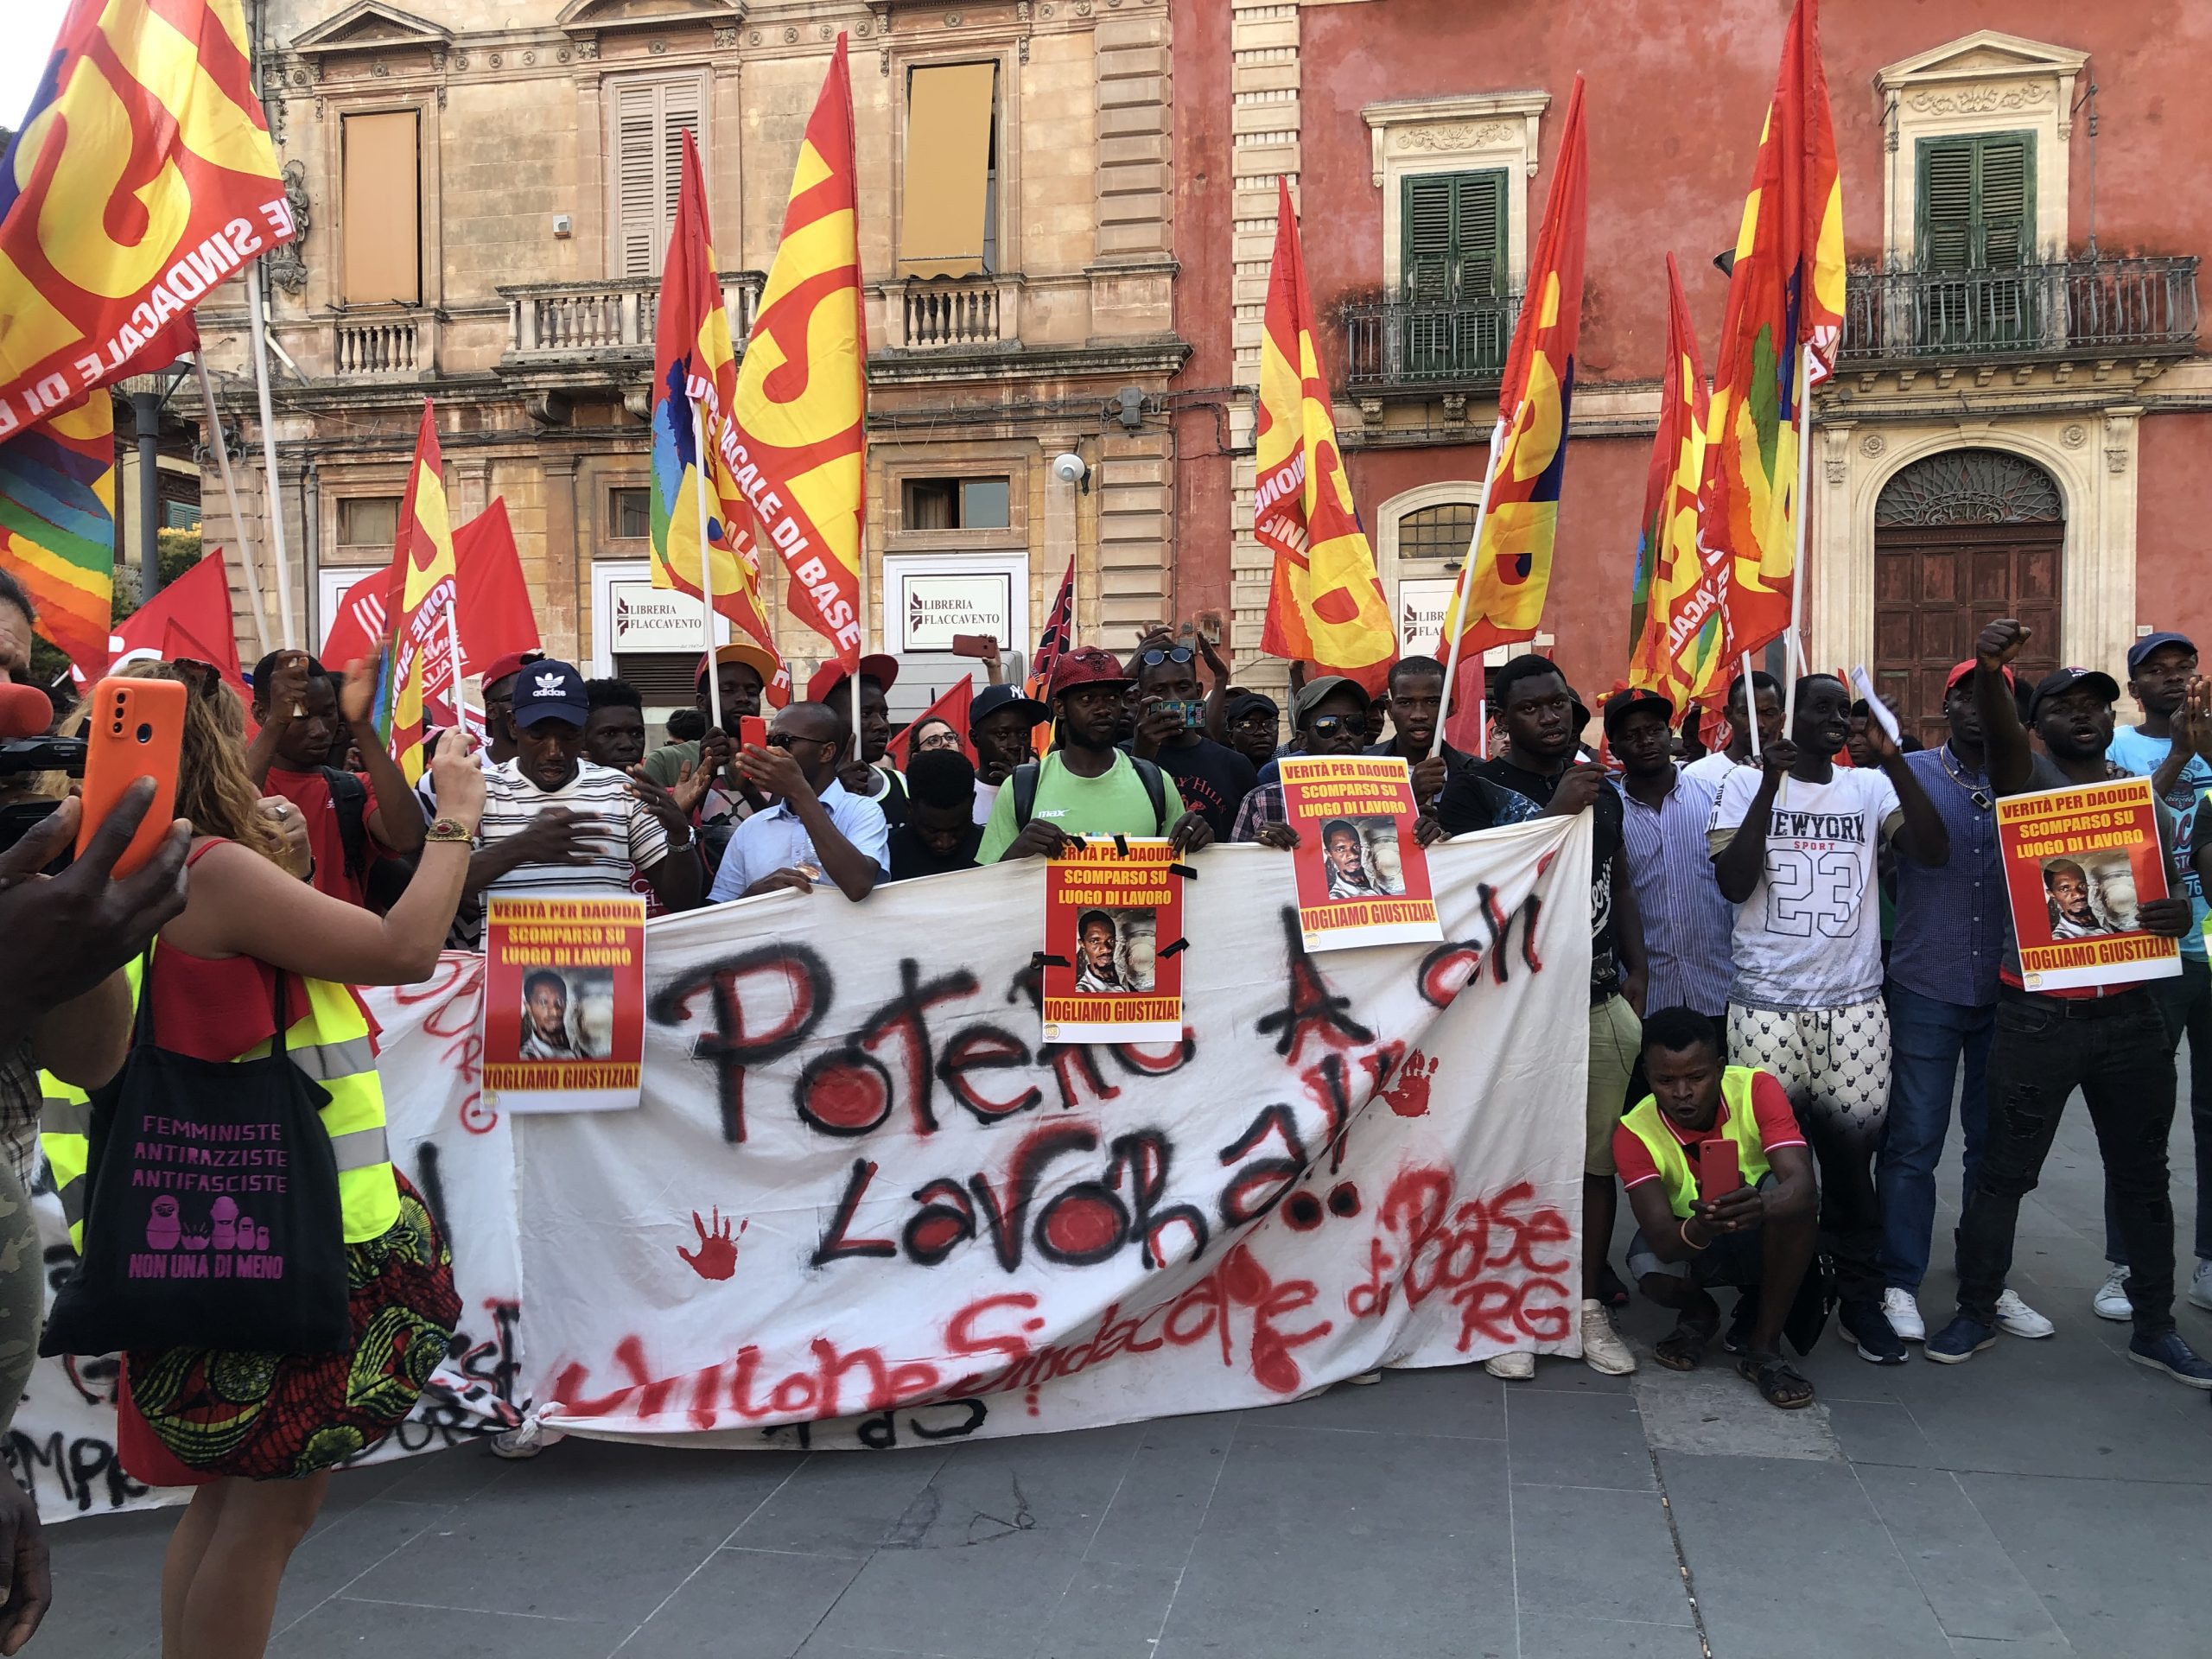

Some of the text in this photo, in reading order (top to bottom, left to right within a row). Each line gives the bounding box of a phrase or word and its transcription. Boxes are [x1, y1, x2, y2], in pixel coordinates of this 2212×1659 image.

[771, 516, 810, 560] DI
[794, 556, 861, 651] BASE
[630, 605, 677, 615] LIBRERIA
[924, 600, 973, 610] LIBRERIA
[630, 619, 702, 630] FLACCAVENTO
[924, 613, 1000, 625] FLACCAVENTO
[532, 688, 567, 697] adidas
[1285, 762, 1406, 779] VERITÀ PER DAOUDA
[1300, 784, 1397, 799] SCOMPARSO SU
[2002, 785, 2149, 819] VERITÀ PER DAOUDA
[1299, 800, 1407, 818] LUOGO DI LAVORO
[2019, 810, 2134, 839] SCOMPARSO SU
[1794, 840, 1835, 850] SPORT
[2016, 829, 2144, 859] LUOGO DI LAVORO
[1064, 869, 1166, 886] SCOMPARSO SU
[1058, 890, 1172, 906] LUOGO DI LAVORO
[1765, 849, 1863, 938] 23
[493, 901, 642, 919] VERITÀ PER DAOUDA
[1301, 902, 1436, 931] VOGLIAMO GIUSTIZIA!
[508, 926, 626, 945] SCOMPARSO SU
[501, 946, 632, 967] LUOGO DI LAVORO
[2021, 937, 2177, 970] VOGLIAMO GIUSTIZIA!
[1045, 1000, 1179, 1022] VOGLIAMO GIUSTIZIA!
[482, 1066, 639, 1090] VOGLIAMO GIUSTIZIA!
[143, 1115, 282, 1141] FEMMINISTE
[133, 1141, 289, 1167] ANTIRAZZISTE
[131, 1168, 288, 1193] ANTIFASCISTE
[129, 1254, 283, 1280] NON UNA DI MENO
